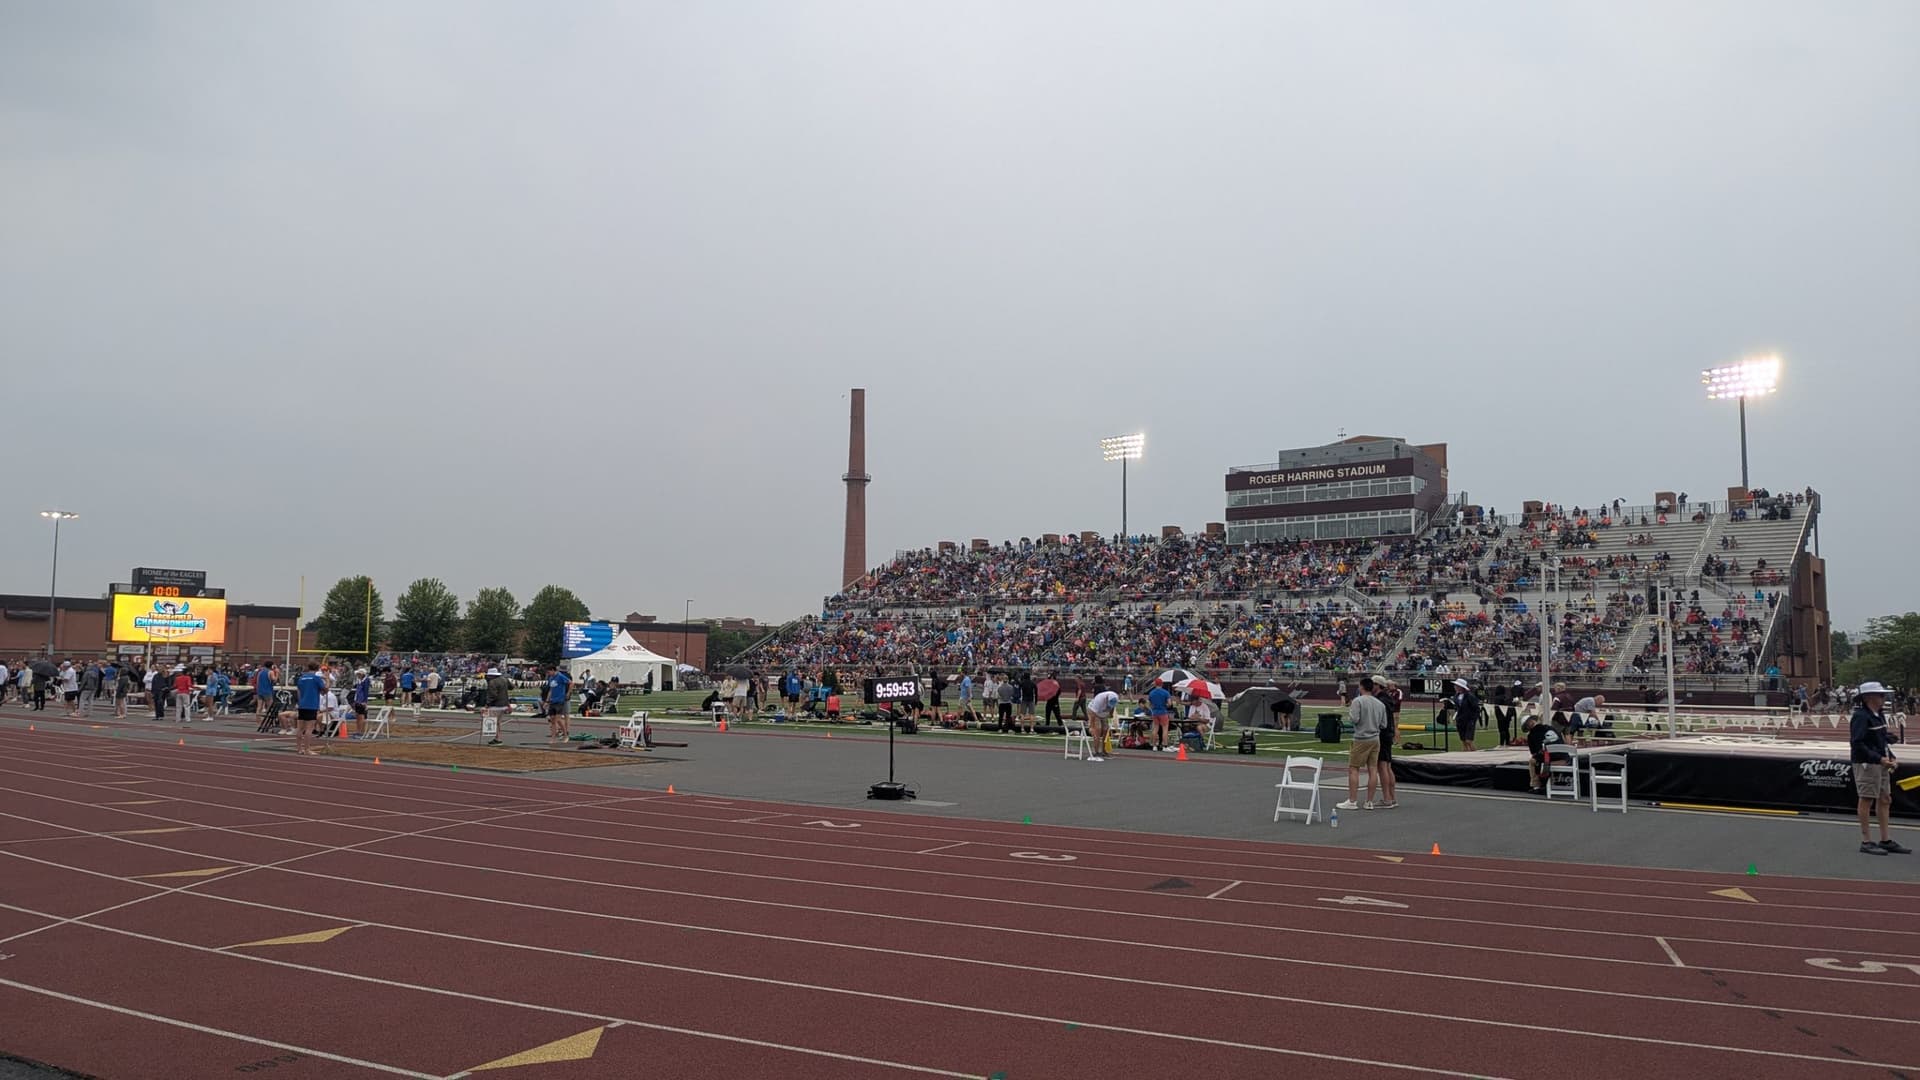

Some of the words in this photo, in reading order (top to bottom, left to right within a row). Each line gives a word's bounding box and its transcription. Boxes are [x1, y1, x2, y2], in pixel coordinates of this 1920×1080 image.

[1249, 473, 1285, 486] ROGER
[1287, 469, 1335, 482] HARRING
[1337, 464, 1386, 477] STADIUM
[153, 586, 179, 597] 10:00
[136, 618, 205, 627] CHAMPIONSHIPS
[876, 681, 915, 698] 9:59:53
[620, 727, 631, 736] PIT
[1800, 760, 1852, 776] Richey
[1009, 852, 1078, 861] 3
